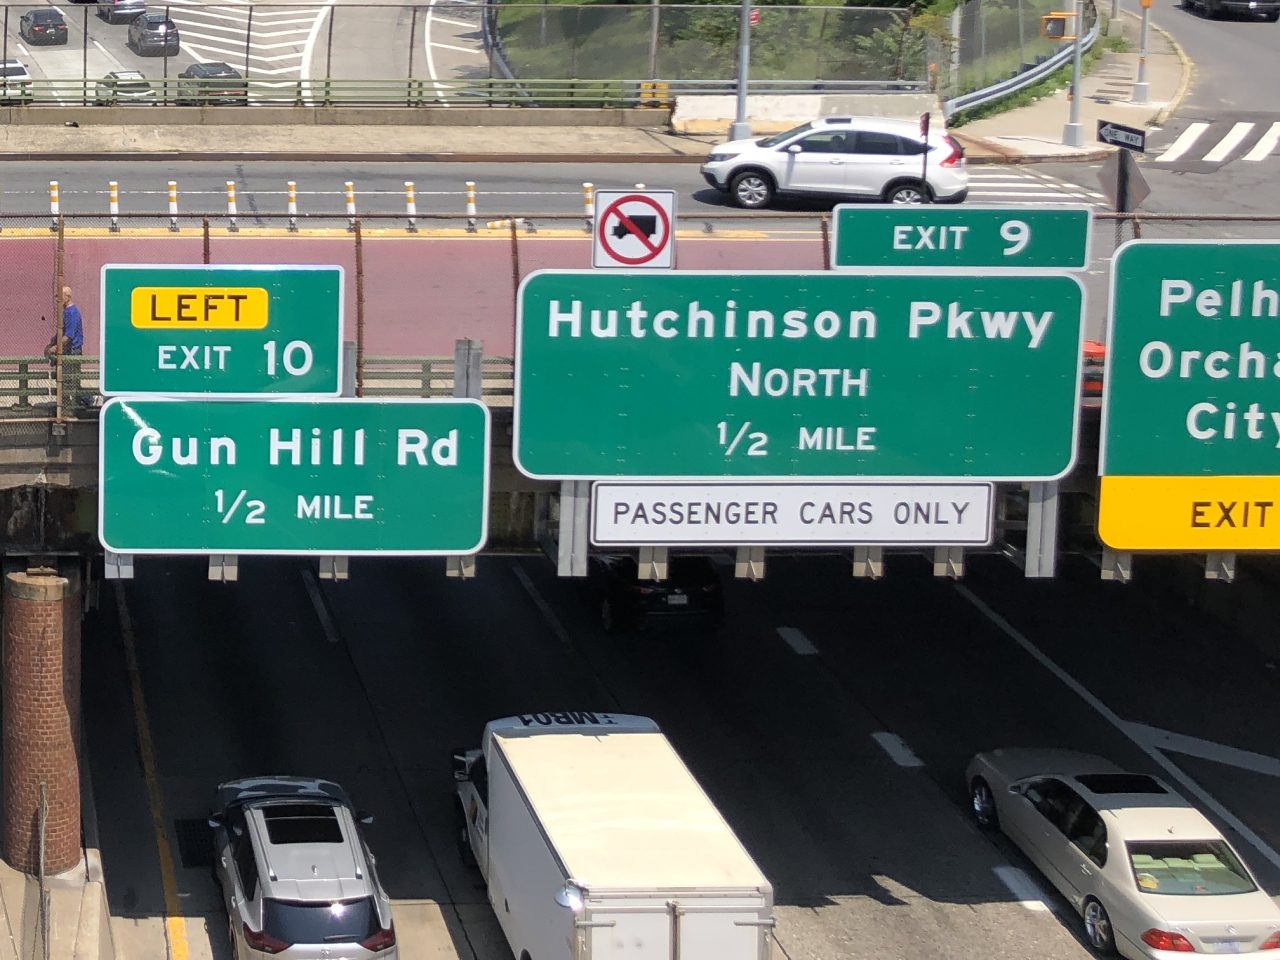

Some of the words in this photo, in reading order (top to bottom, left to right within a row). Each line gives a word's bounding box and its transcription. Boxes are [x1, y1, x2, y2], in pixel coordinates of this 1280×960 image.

[1103, 128, 1119, 140] ONE
[1124, 134, 1140, 146] WAY
[893, 225, 969, 250] EXIT
[1000, 220, 1030, 256] 9
[150, 295, 248, 322] LEFT
[1160, 279, 1279, 317] Pelh
[548, 300, 877, 339] Hutchinson
[908, 301, 1054, 348] Pkwy
[158, 345, 232, 370] EXIT
[263, 340, 313, 376] 10
[1139, 340, 1280, 379] Orch
[729, 362, 868, 397] NORTH
[132, 428, 237, 466] Gun
[269, 427, 365, 465] Hill
[397, 428, 458, 466] Rd
[798, 427, 876, 451] MILE
[296, 495, 374, 519] MILE
[613, 502, 778, 525] PASSENGER
[799, 501, 873, 525] CARS
[893, 501, 970, 525] ONLY
[1191, 501, 1273, 528] EXIT
